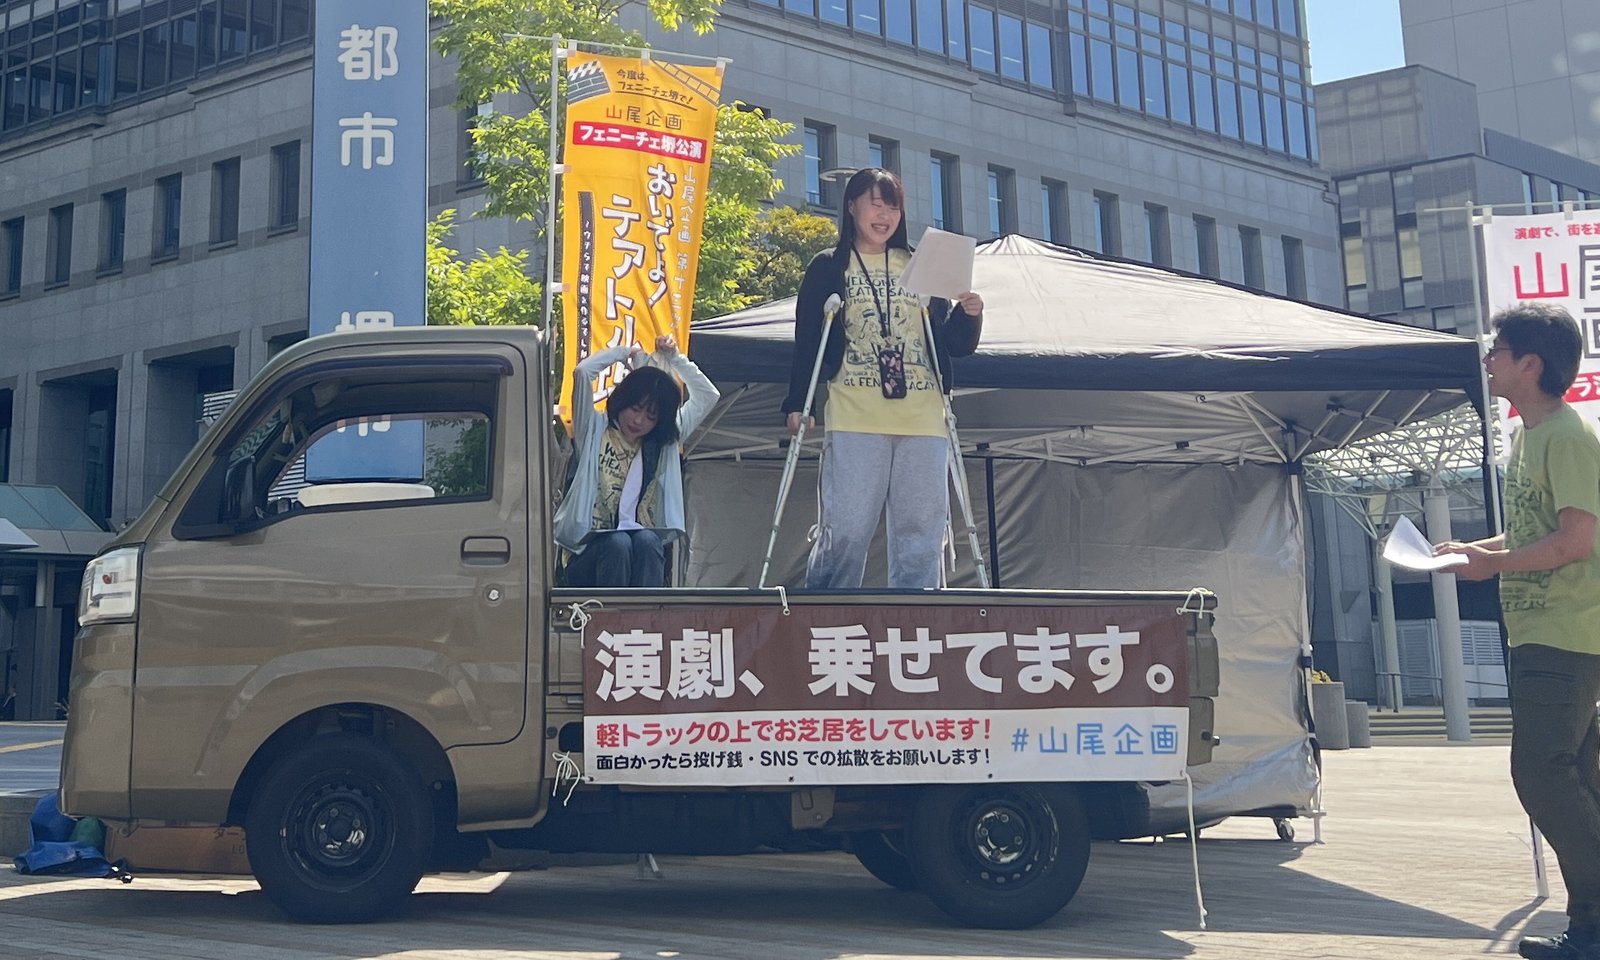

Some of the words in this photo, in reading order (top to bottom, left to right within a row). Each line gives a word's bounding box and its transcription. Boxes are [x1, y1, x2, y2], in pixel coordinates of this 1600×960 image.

[606, 105, 682, 131] 山尾企画
[580, 125, 703, 159] フェニーチェ堺公演
[595, 624, 1175, 702] 演劇、乗せてます。
[596, 717, 991, 748] 軽トラックの上でお芝居をしています!
[1011, 723, 1178, 755] #山尾企画
